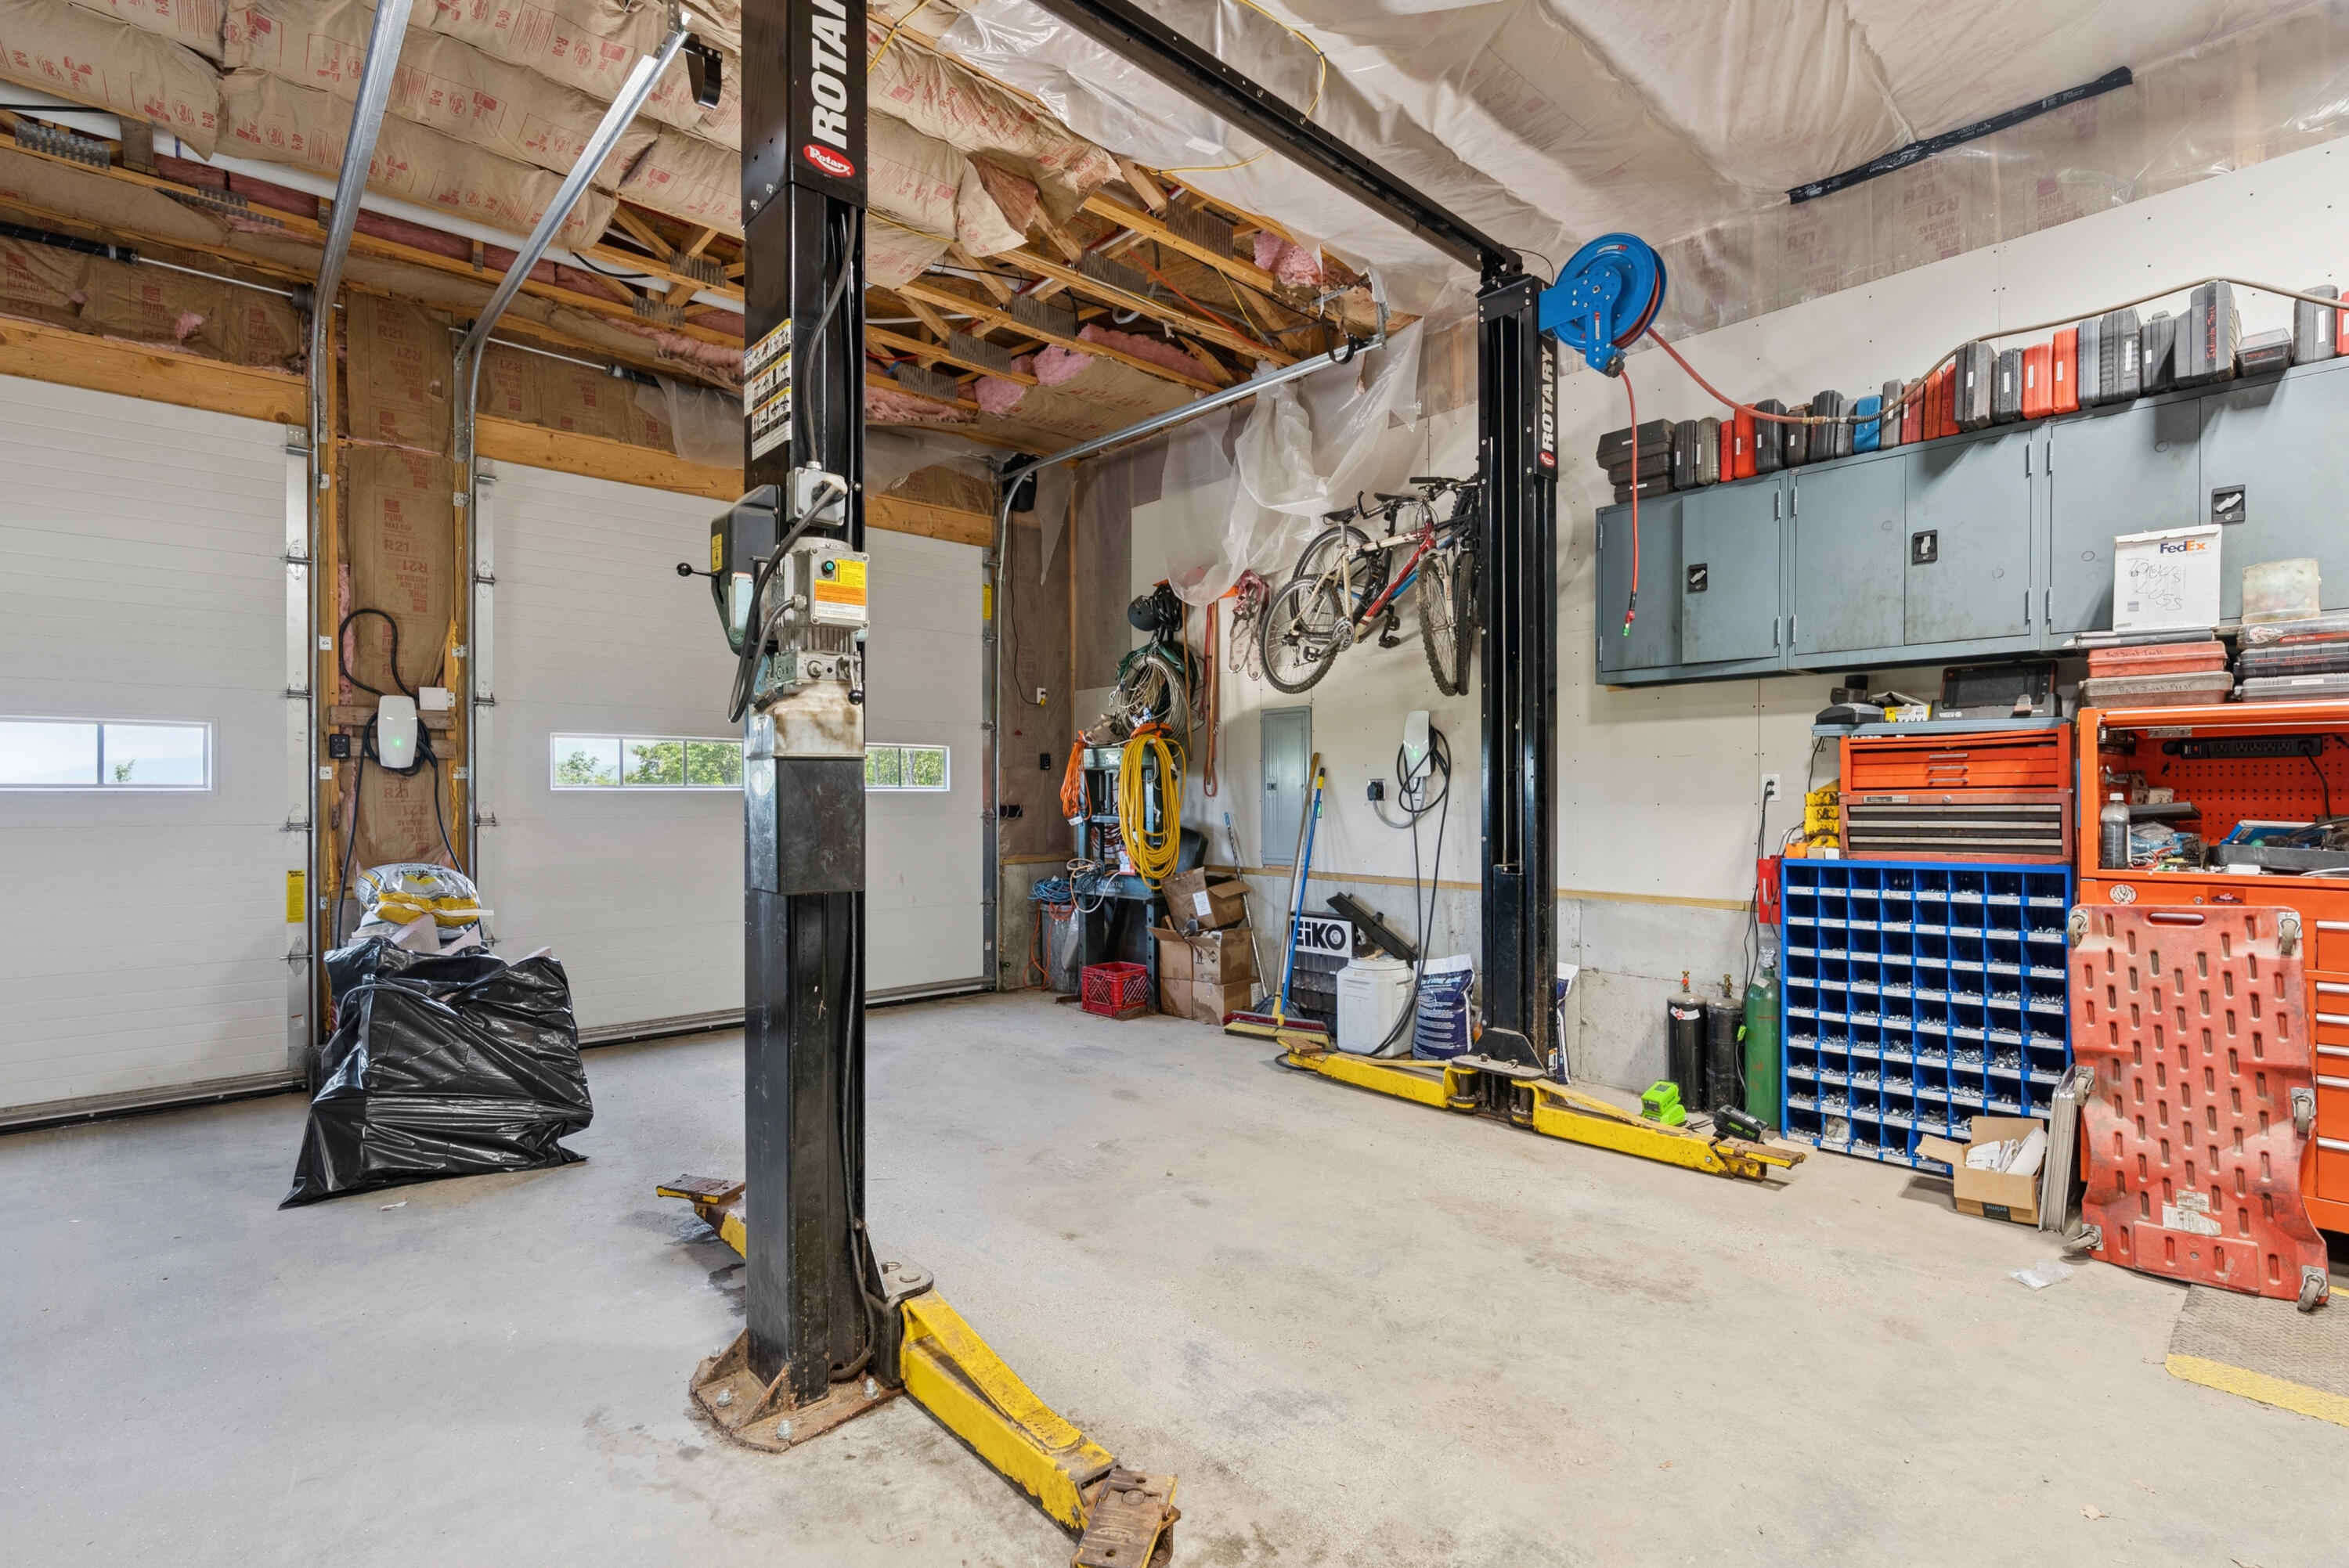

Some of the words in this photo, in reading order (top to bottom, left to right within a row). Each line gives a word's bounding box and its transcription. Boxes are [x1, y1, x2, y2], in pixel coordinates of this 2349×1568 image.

[552, 36, 569, 57] R-30
[809, 144, 850, 174] Rotary
[1073, 157, 1093, 174] R-30
[1904, 181, 1936, 204] R21
[1927, 196, 1958, 219] R21
[2037, 196, 2063, 211] PINK
[1788, 231, 1815, 251] R21
[395, 346, 423, 362] R21
[1541, 343, 1554, 452] ROTARY
[384, 538, 410, 553] R21
[2160, 539, 2207, 554] FedEx
[402, 559, 428, 575] R21
[2119, 686, 2137, 694] Ball
[384, 788, 409, 798] R21
